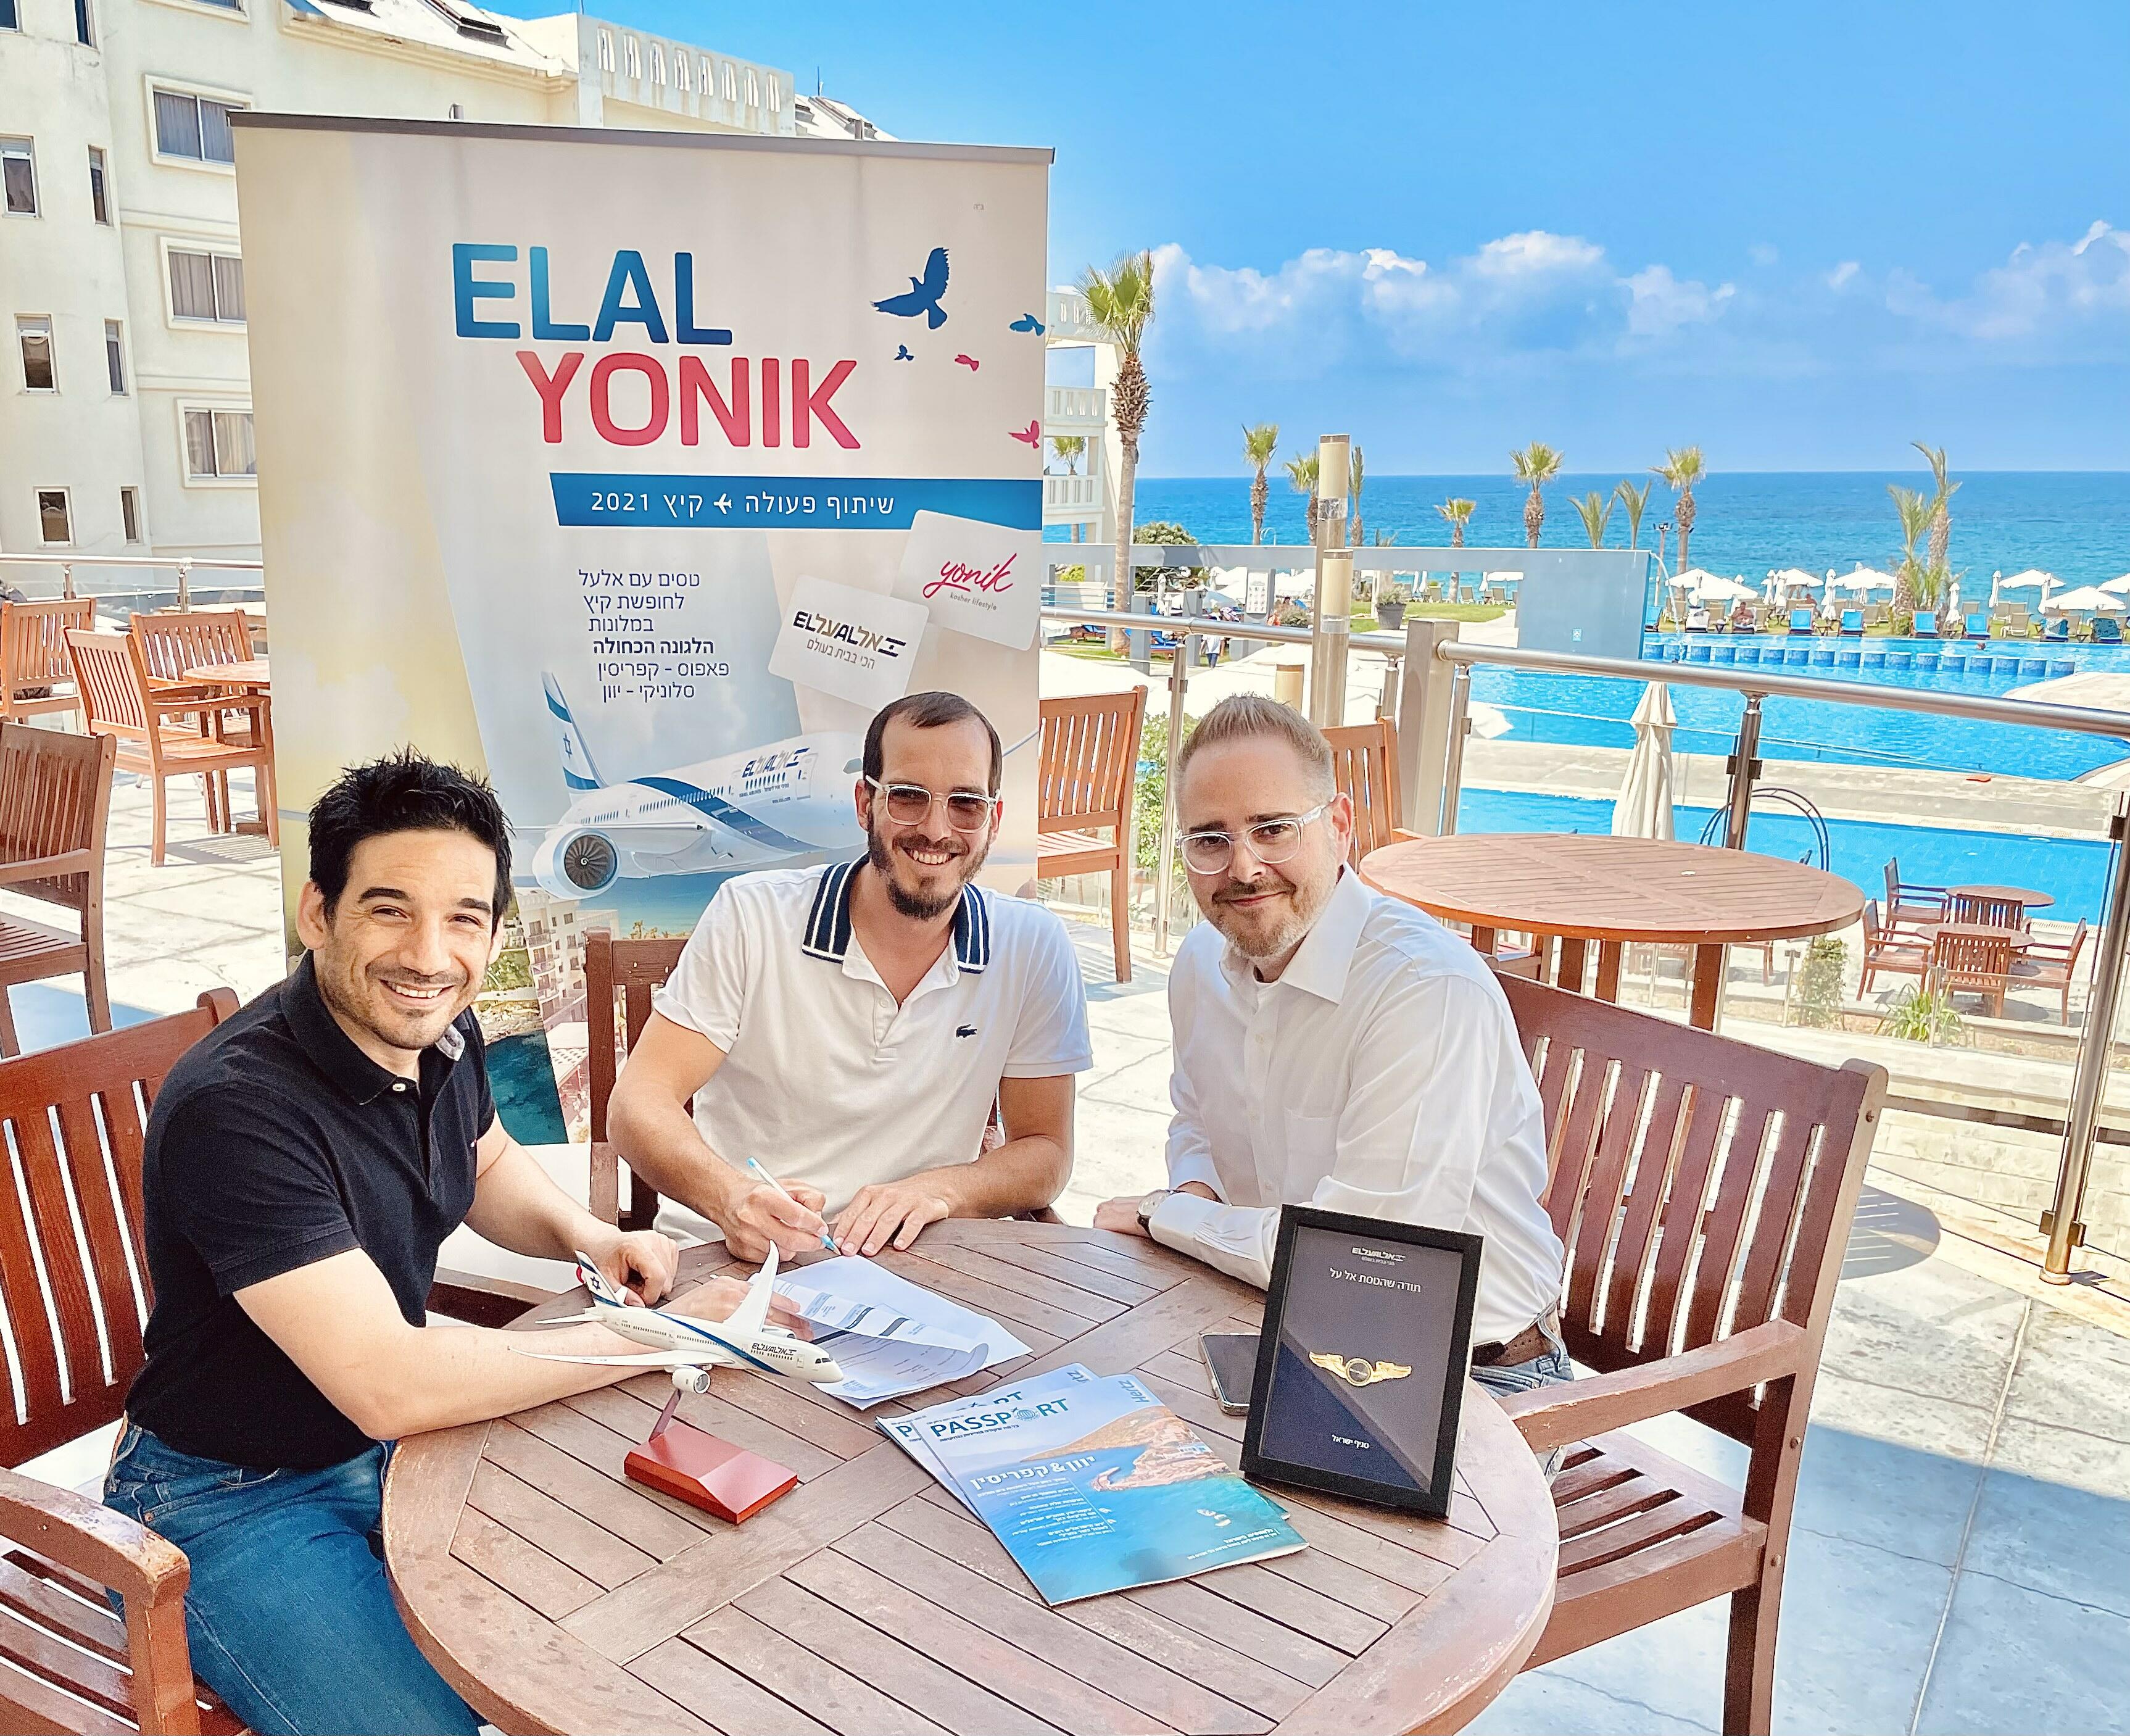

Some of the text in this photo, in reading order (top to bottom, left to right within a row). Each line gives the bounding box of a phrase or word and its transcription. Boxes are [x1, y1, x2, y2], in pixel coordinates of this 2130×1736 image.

[452, 243, 732, 346] ELAL
[515, 351, 861, 450] YONIK
[591, 491, 894, 520] שיתוף פעולה קיץ 2021
[578, 568, 700, 588] טסים עם אלעל
[922, 552, 1017, 599] yonik
[583, 592, 685, 614] לחופשת קיץ
[950, 591, 998, 612] kosher lifestyle
[588, 615, 654, 632] במלונות
[592, 637, 715, 654] הלגונה הכחולה
[806, 638, 875, 670] הכי בבית בעולם
[599, 663, 660, 681] קפריסין
[678, 663, 730, 676] פאפוס
[602, 685, 621, 703] יוון
[639, 681, 695, 703] סלוניקי
[1330, 1267, 1343, 1279] על
[1344, 1269, 1357, 1282] אל
[1397, 1281, 1421, 1293] תודה
[1117, 1379, 1150, 1403] Hertz
[1332, 1434, 1353, 1445] ישראל
